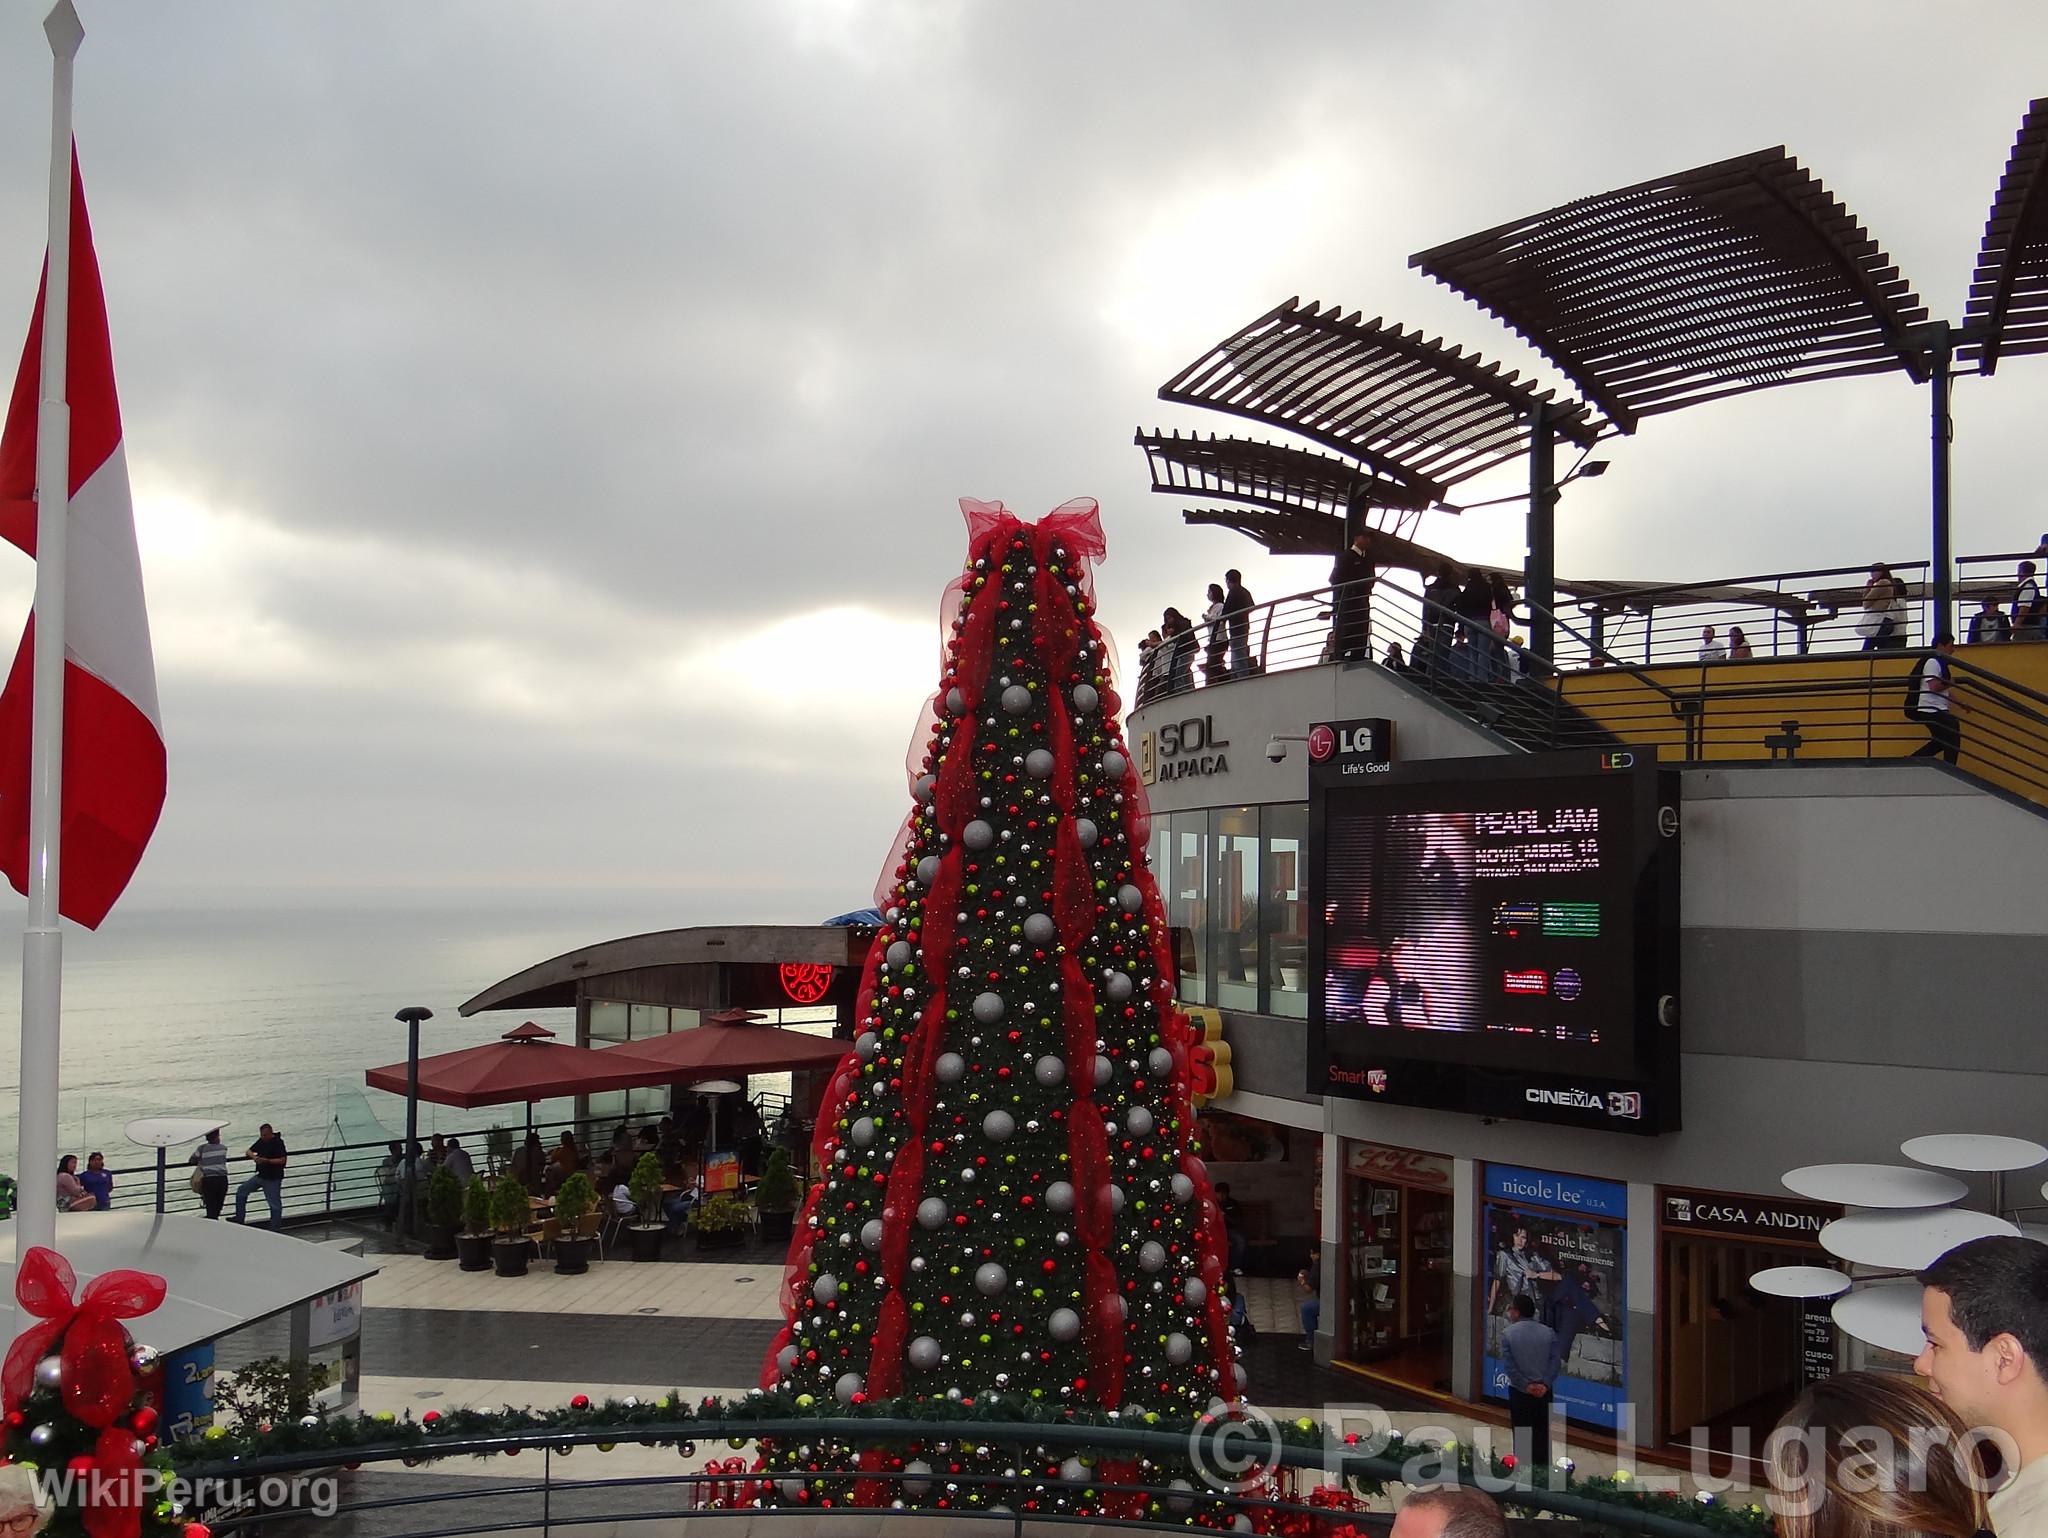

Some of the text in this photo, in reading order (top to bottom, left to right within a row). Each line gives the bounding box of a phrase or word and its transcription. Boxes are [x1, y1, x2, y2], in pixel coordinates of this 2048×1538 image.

[1159, 715, 1230, 757] SOL
[1340, 727, 1373, 754] LG
[1159, 753, 1230, 783] ALPACA
[1342, 761, 1390, 775] Life's Good
[1601, 752, 1634, 769] LED
[1475, 808, 1599, 835] PEARL JAM
[1328, 1064, 1366, 1085] Smart
[1525, 1087, 1641, 1119] CINEMA 3D
[1502, 1178, 1553, 1200] nicole
[1556, 1182, 1581, 1204] lee
[1695, 1204, 1749, 1224] CASA
[1541, 1232, 1576, 1248] nicole
[1578, 1235, 1597, 1252] lee
[1804, 1313, 1833, 1324] arequ
[1805, 1350, 1833, 1360] cusco
